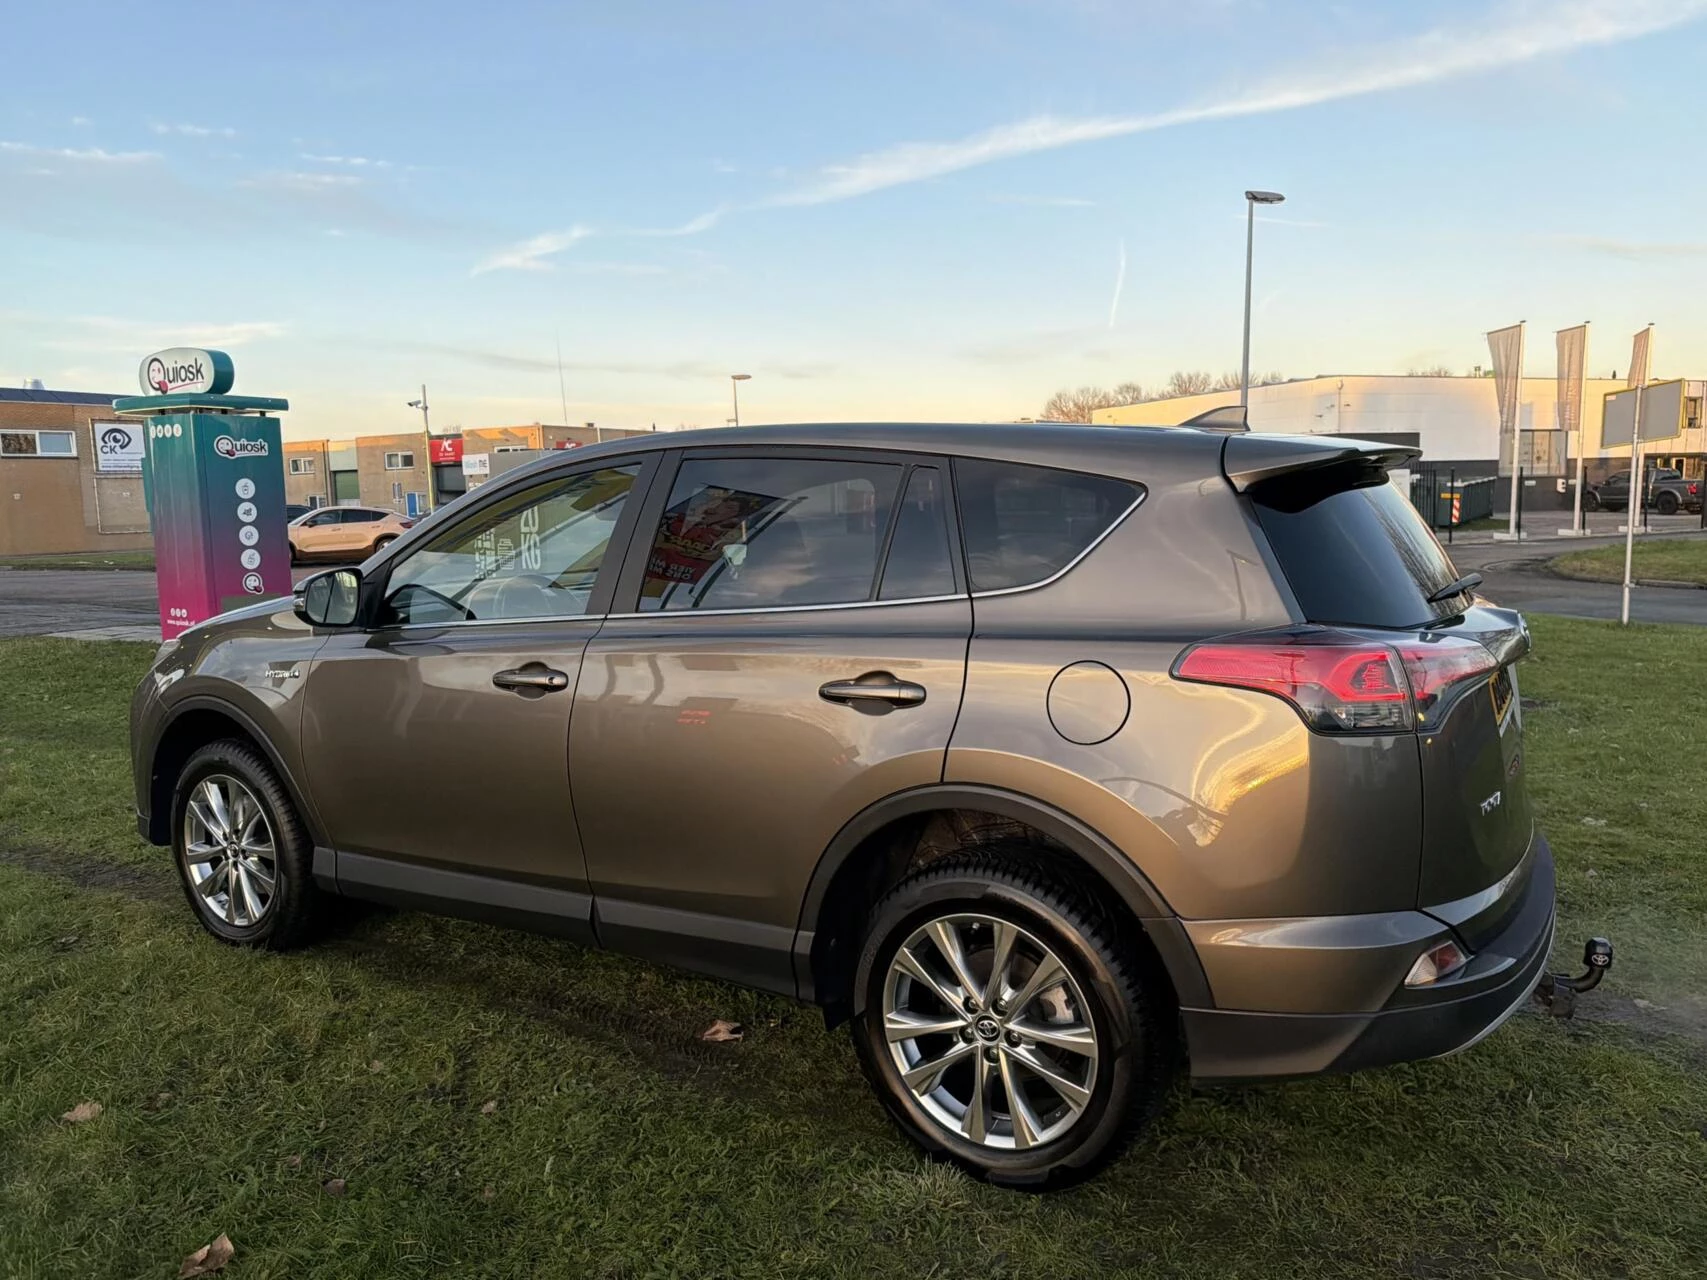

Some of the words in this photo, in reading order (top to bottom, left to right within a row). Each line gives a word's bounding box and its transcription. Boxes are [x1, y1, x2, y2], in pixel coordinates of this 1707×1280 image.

[148, 357, 205, 394] Quiosk
[101, 445, 117, 454] CK
[216, 437, 267, 456] Quiosk
